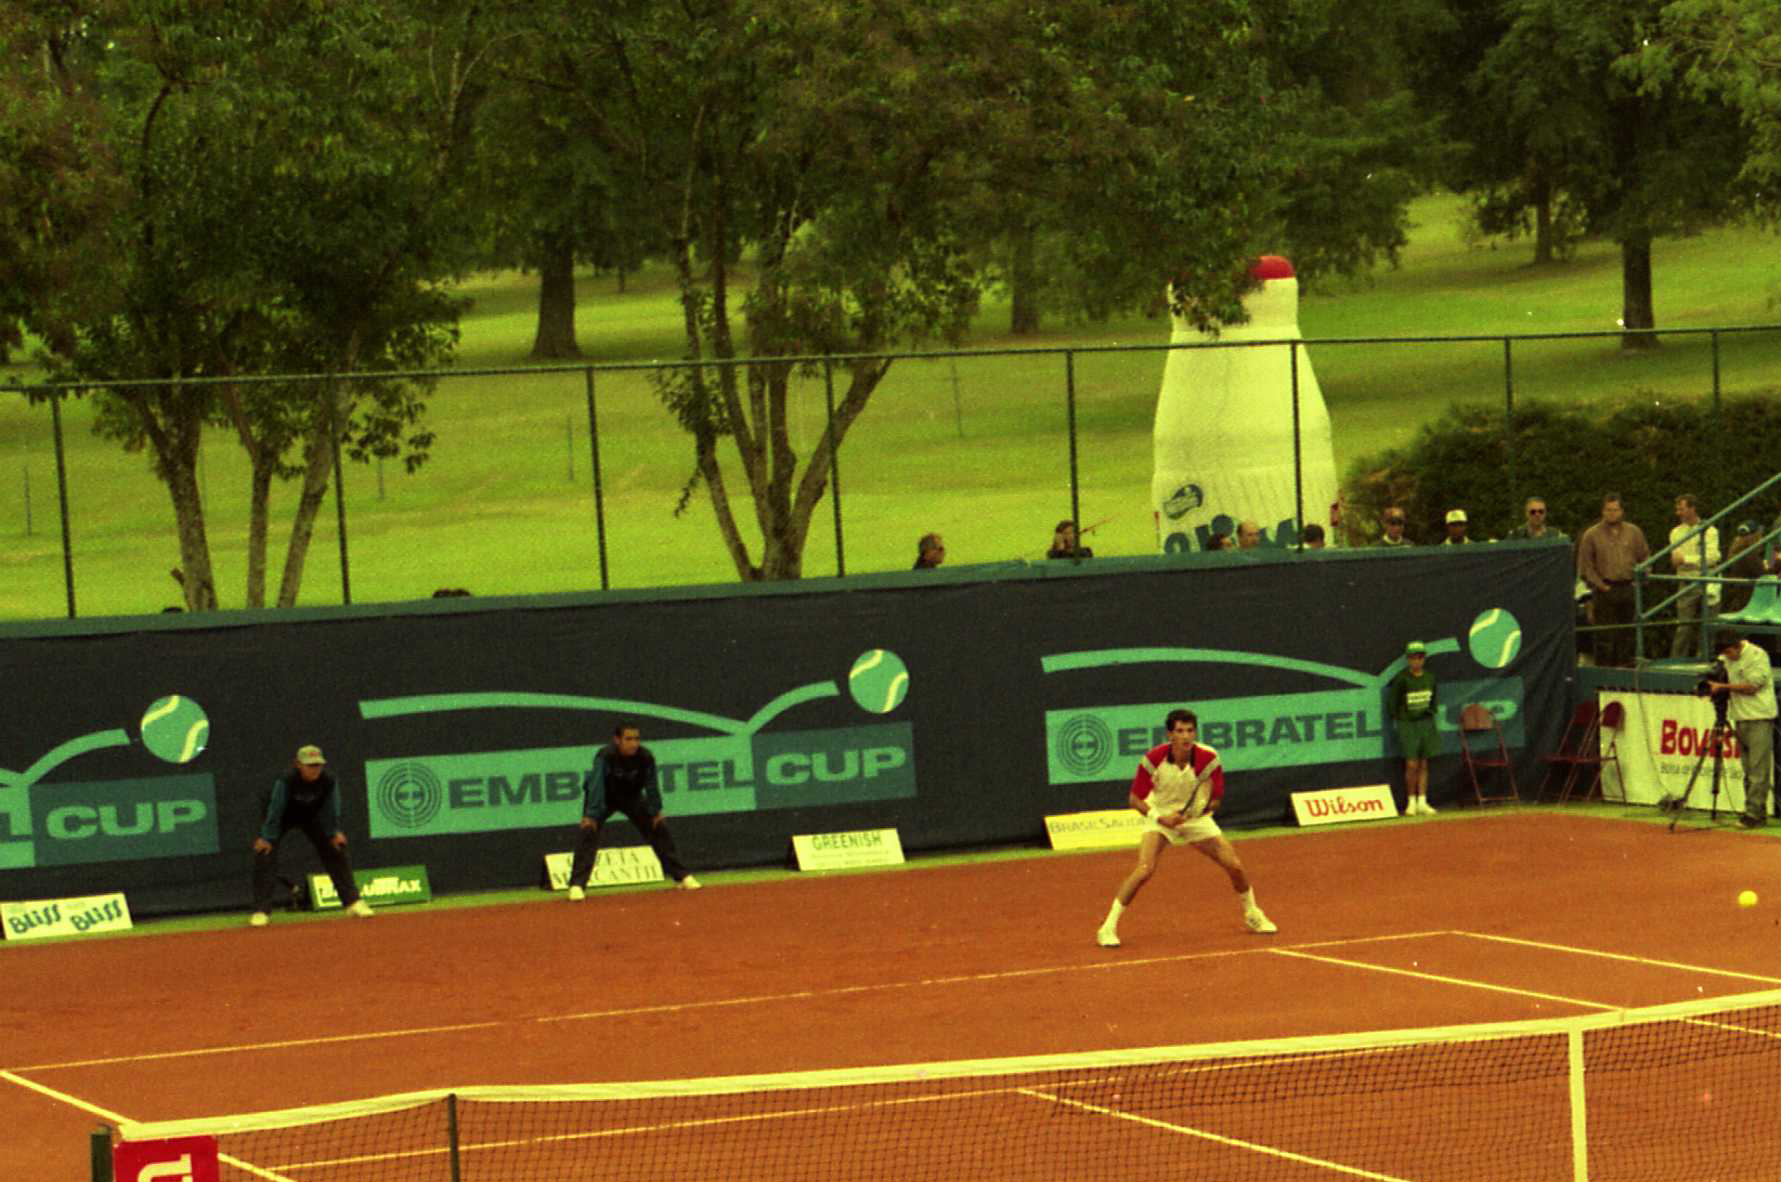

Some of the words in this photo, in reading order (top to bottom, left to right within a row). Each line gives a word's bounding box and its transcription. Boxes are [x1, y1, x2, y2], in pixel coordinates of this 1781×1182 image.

[1118, 709, 1382, 757] EBRATEL
[449, 759, 755, 810] EMBTEL
[766, 746, 907, 786] CUP
[46, 799, 207, 840] CUP
[1304, 796, 1384, 817] Wilson
[811, 831, 883, 851] GREENISH
